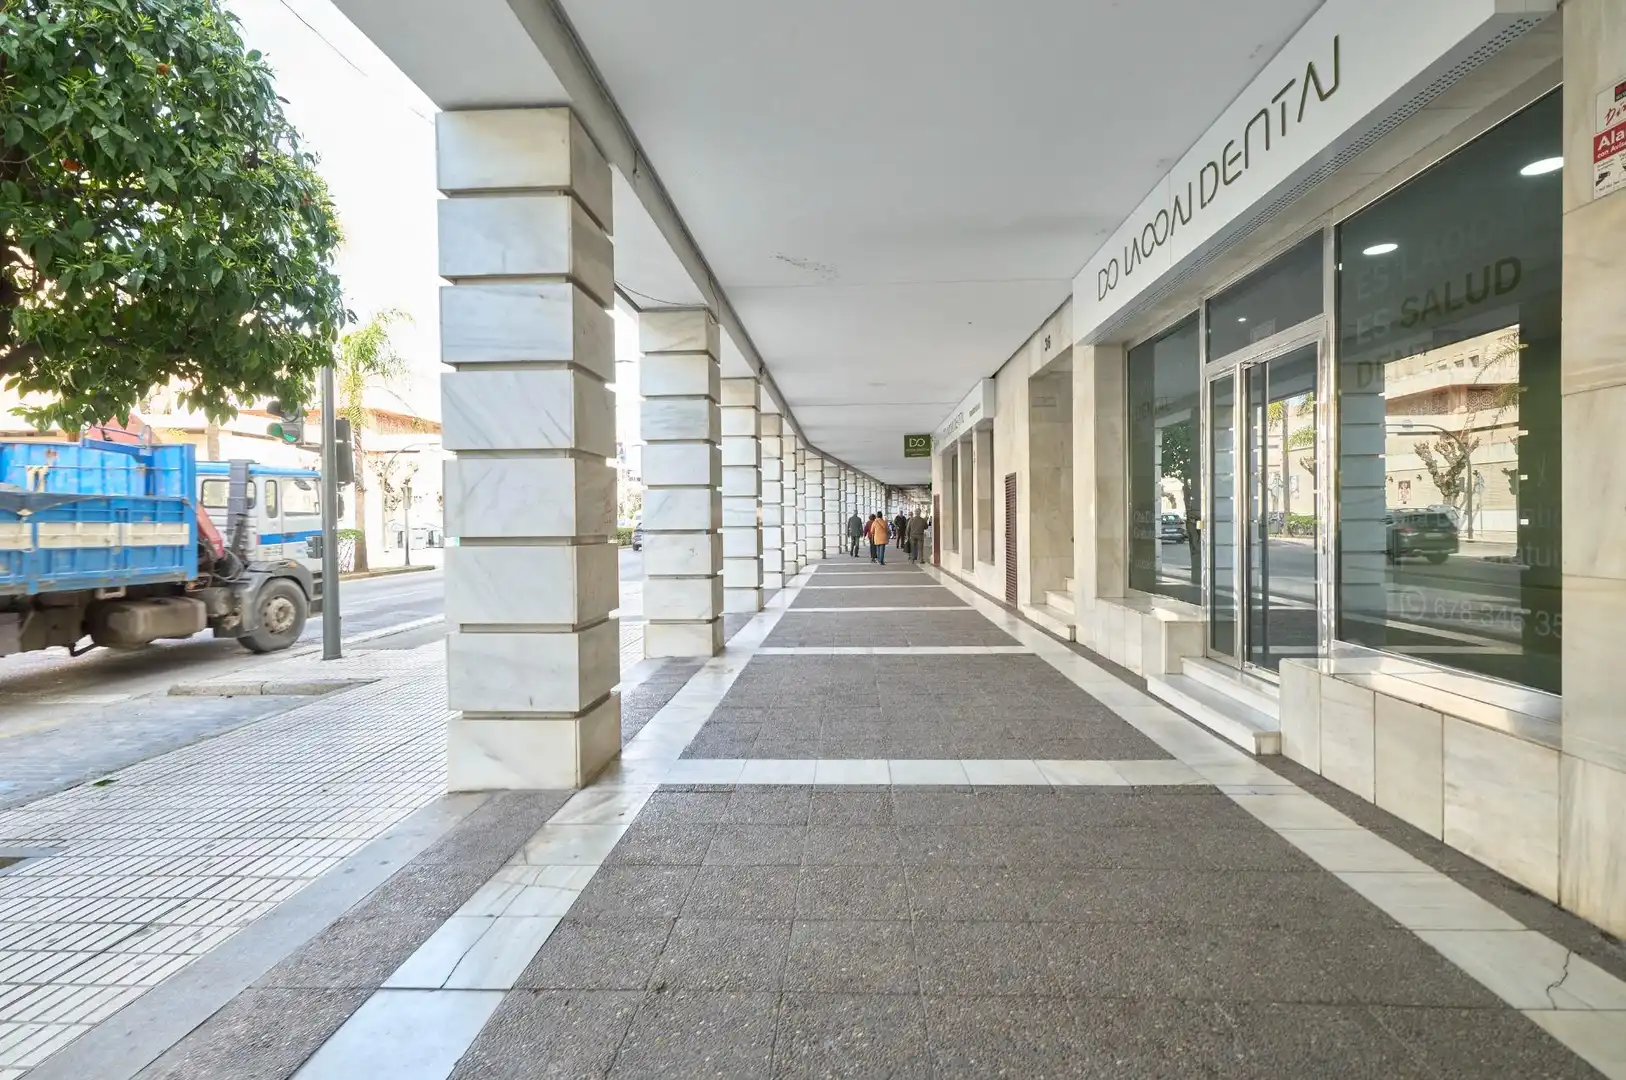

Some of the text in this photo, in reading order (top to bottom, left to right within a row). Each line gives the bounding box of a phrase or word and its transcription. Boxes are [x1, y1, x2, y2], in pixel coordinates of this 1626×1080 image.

[1098, 258, 1119, 301] DO
[1200, 34, 1340, 210] DENTAL
[1400, 256, 1523, 330] SALUD
[909, 437, 926, 448] DO
[1434, 597, 1472, 624] 678
